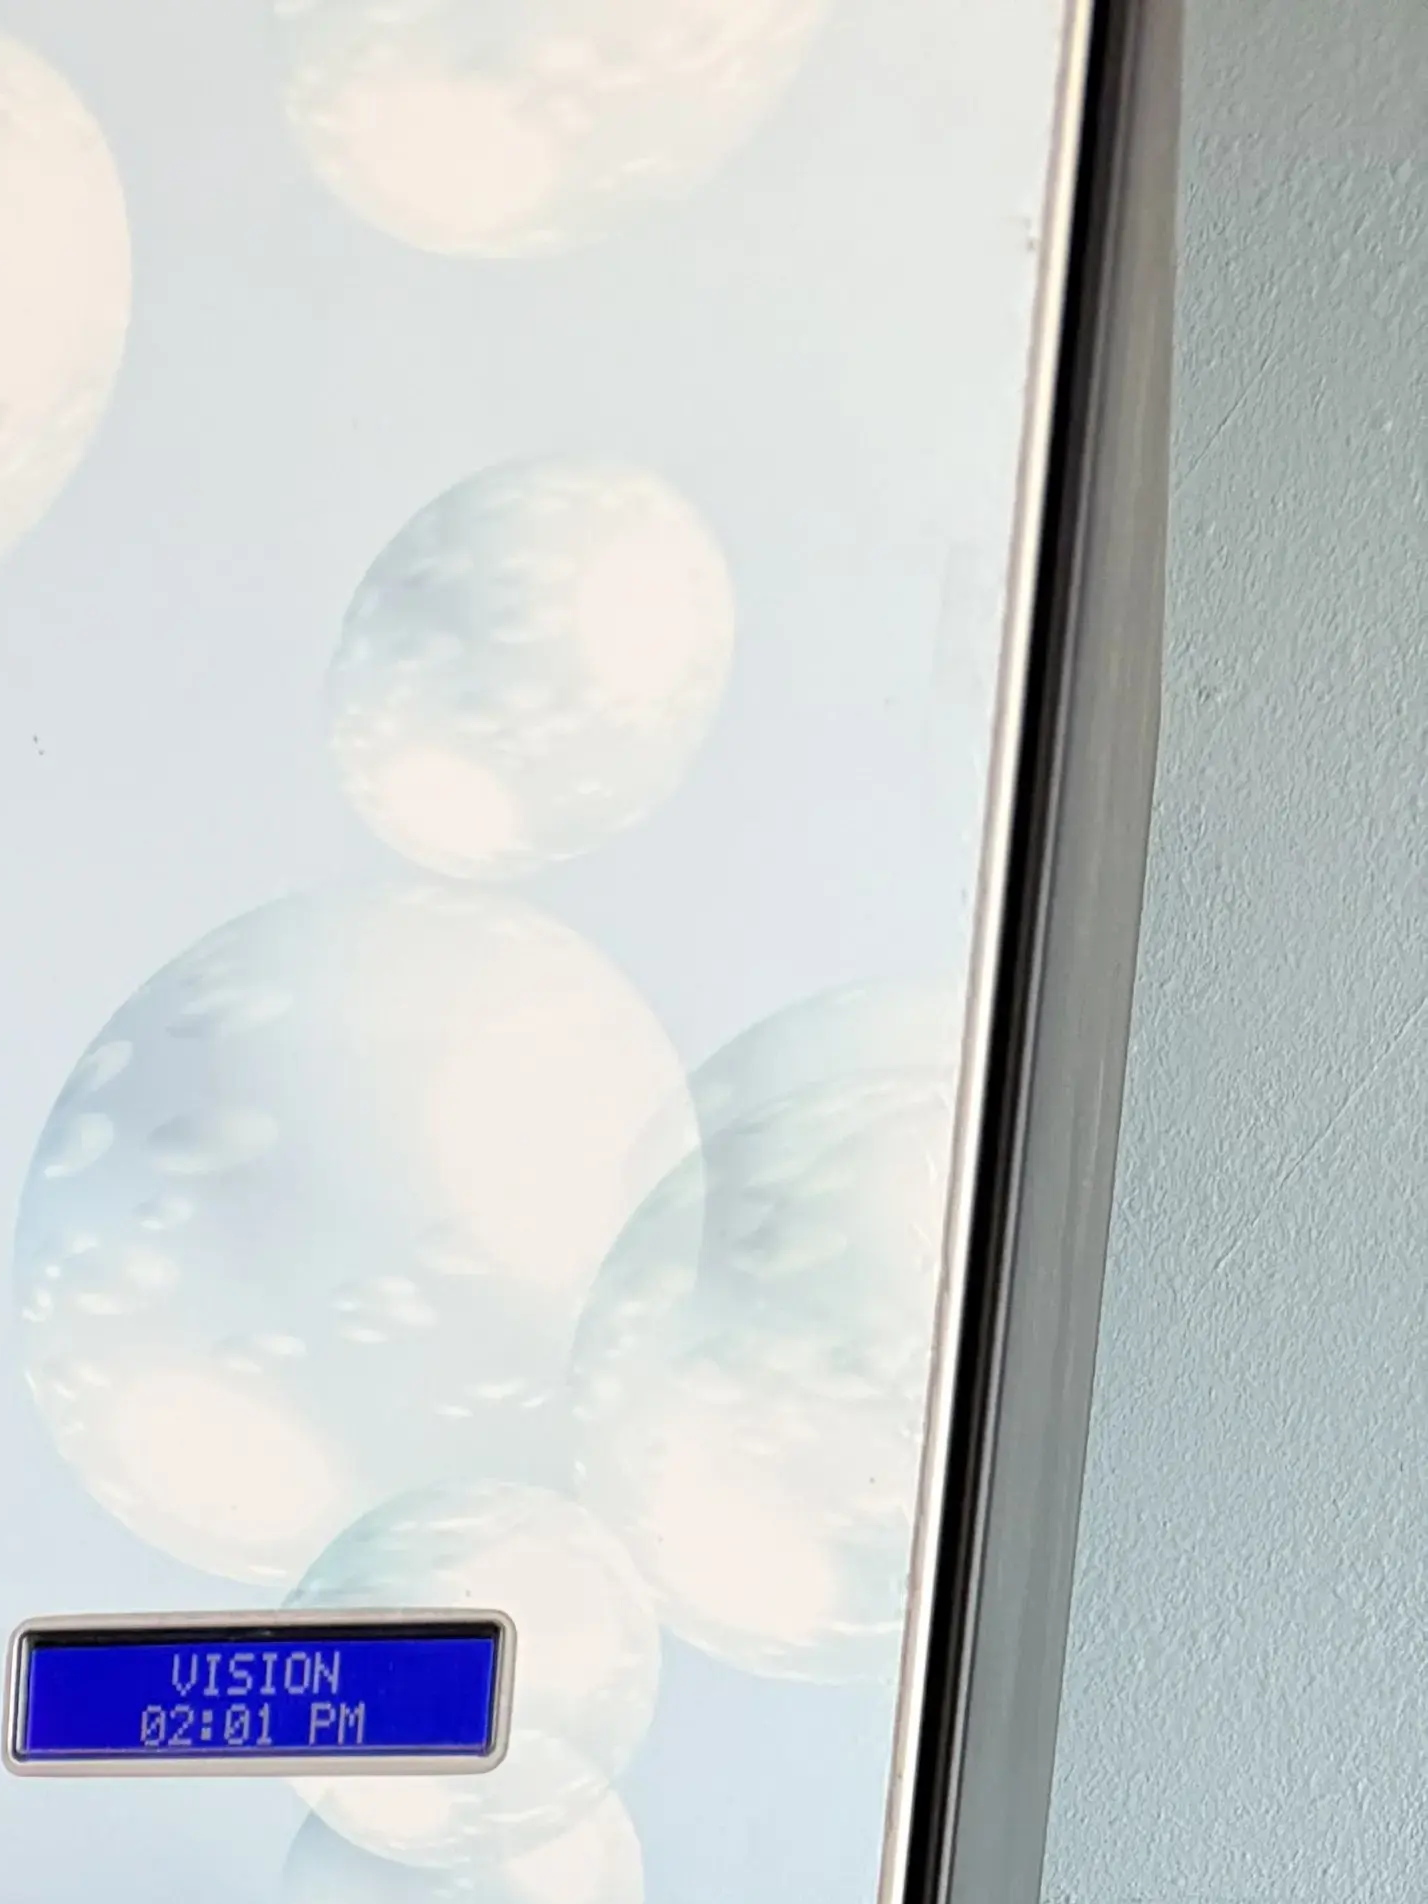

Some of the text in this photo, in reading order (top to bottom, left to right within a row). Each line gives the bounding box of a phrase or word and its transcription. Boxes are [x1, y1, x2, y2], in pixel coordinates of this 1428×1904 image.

[169, 1651, 342, 1696] VISION
[142, 1702, 366, 1747] 02:01 PM
